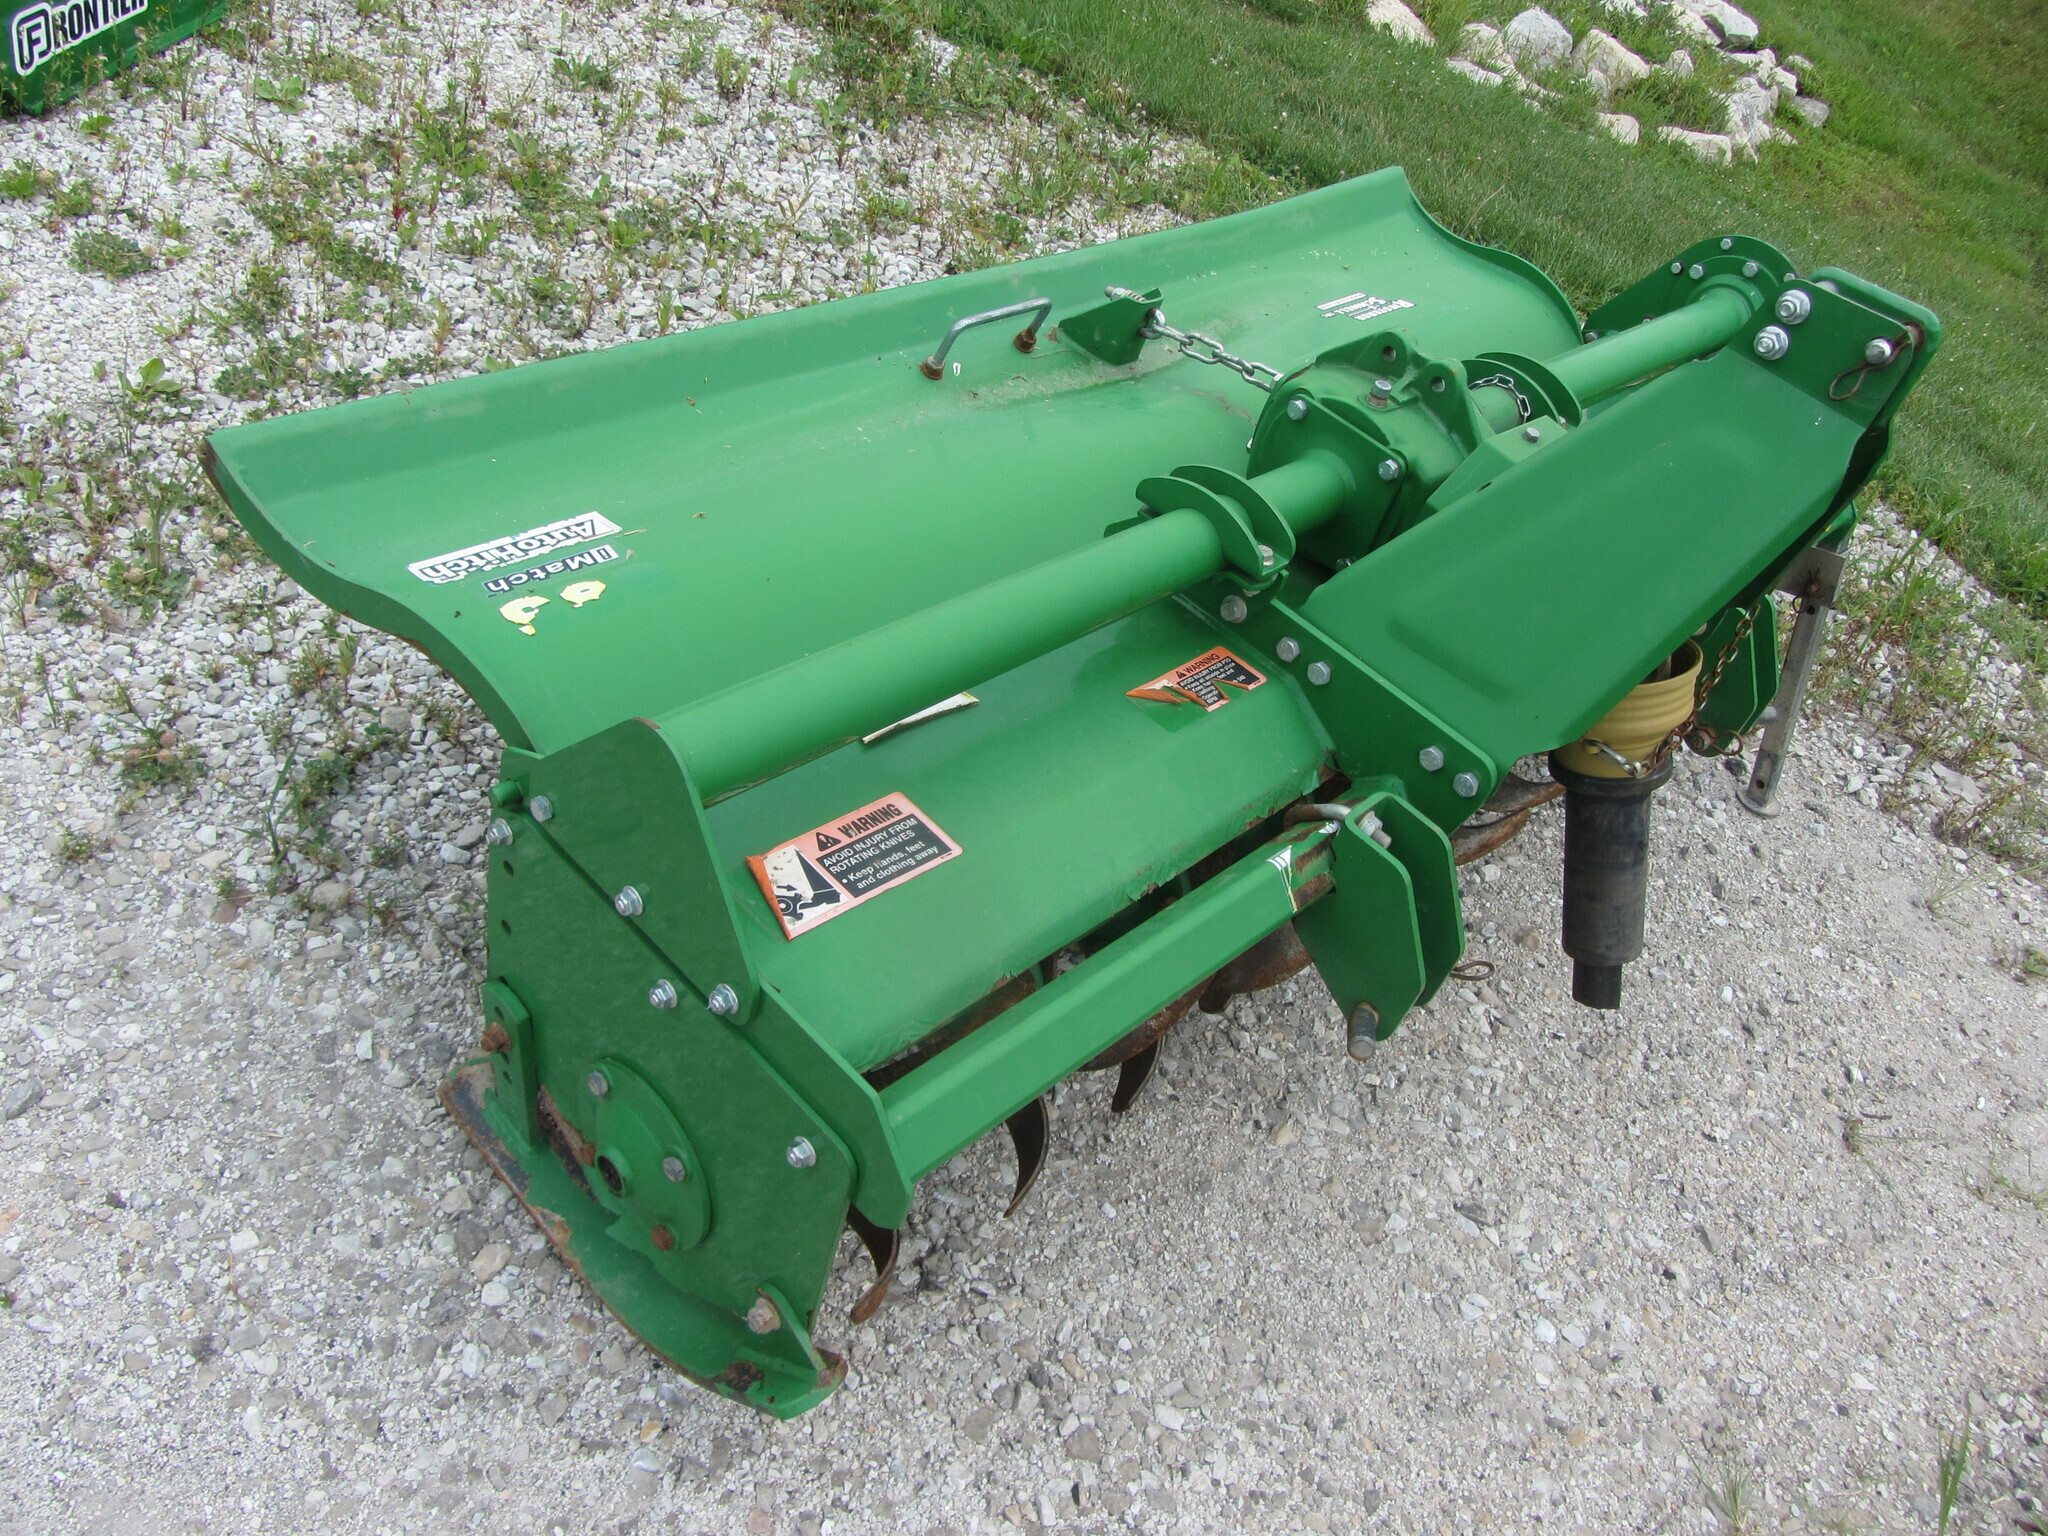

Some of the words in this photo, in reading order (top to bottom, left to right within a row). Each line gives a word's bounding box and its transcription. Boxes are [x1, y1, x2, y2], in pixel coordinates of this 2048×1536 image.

[15, 0, 147, 72] FRONTI
[419, 518, 598, 583] AutoHitch
[484, 545, 617, 592] iMatch
[1183, 653, 1221, 674] WARNING
[823, 847, 854, 867] AVOID
[852, 831, 888, 852] INJURY
[888, 817, 918, 835] FROM
[837, 803, 903, 839] WARNING
[829, 846, 880, 875] ROTATING
[879, 829, 916, 851] KNIVES
[847, 865, 875, 883] Keep
[905, 840, 926, 854] feet
[856, 875, 876, 889] and
[876, 856, 916, 880] clothing
[914, 845, 939, 861] away
